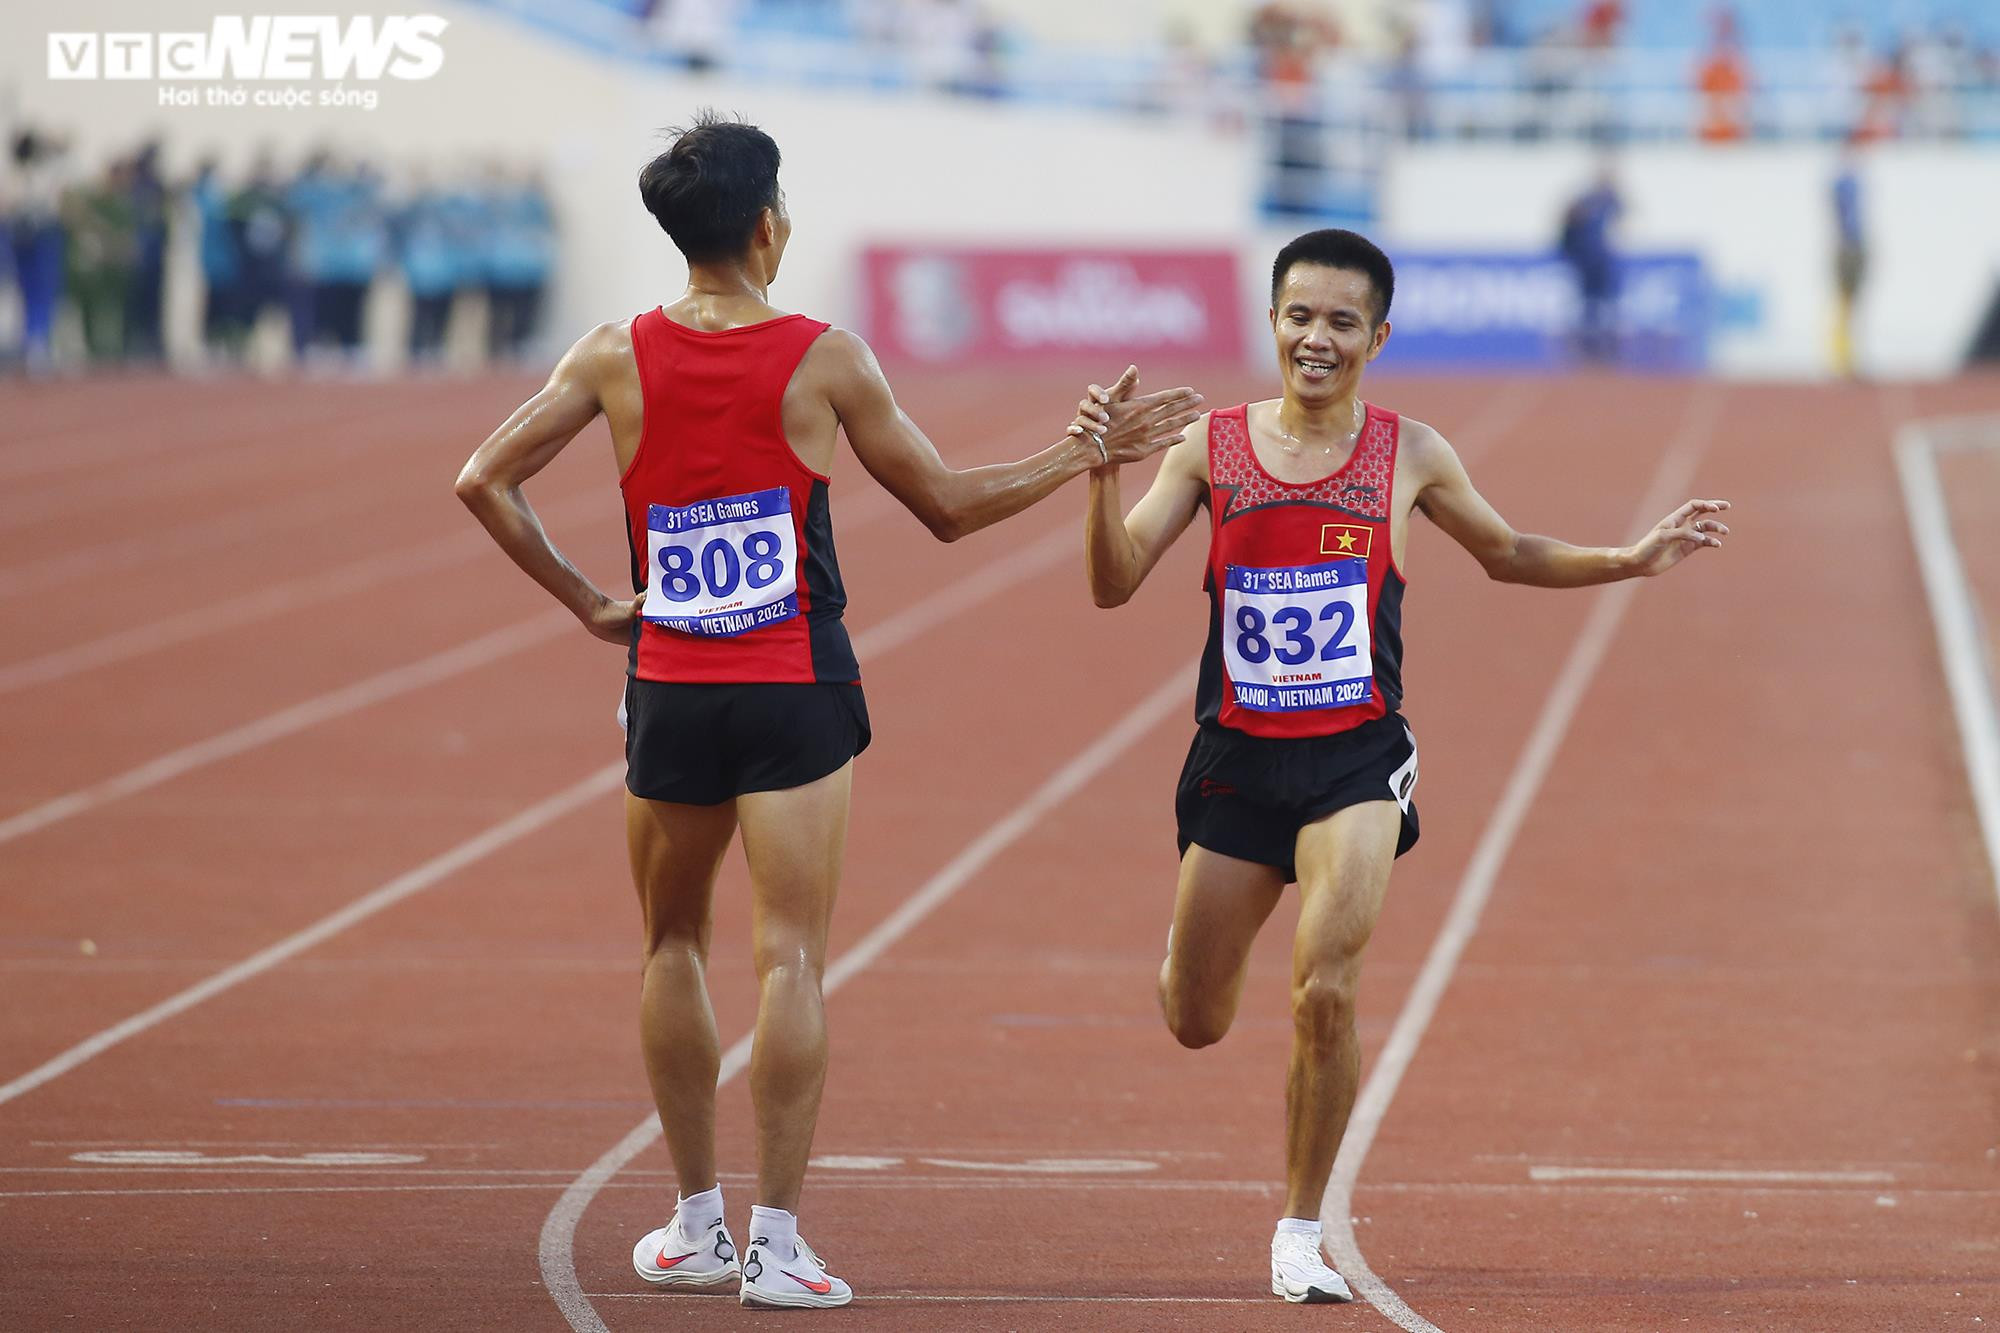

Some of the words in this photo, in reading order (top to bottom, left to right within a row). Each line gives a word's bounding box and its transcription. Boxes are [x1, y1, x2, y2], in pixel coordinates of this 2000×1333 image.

[690, 503, 716, 525] SEA
[717, 500, 759, 519] Games
[658, 530, 784, 602] 808
[1268, 572, 1293, 590] SEA
[1295, 569, 1339, 588] Games
[698, 601, 743, 614] VIETNAM
[700, 613, 755, 634] VIETNAM
[757, 601, 787, 624] 2022
[1236, 600, 1357, 665] 832
[1272, 673, 1322, 683] VIETNAM
[1278, 686, 1334, 707] VIETNAM
